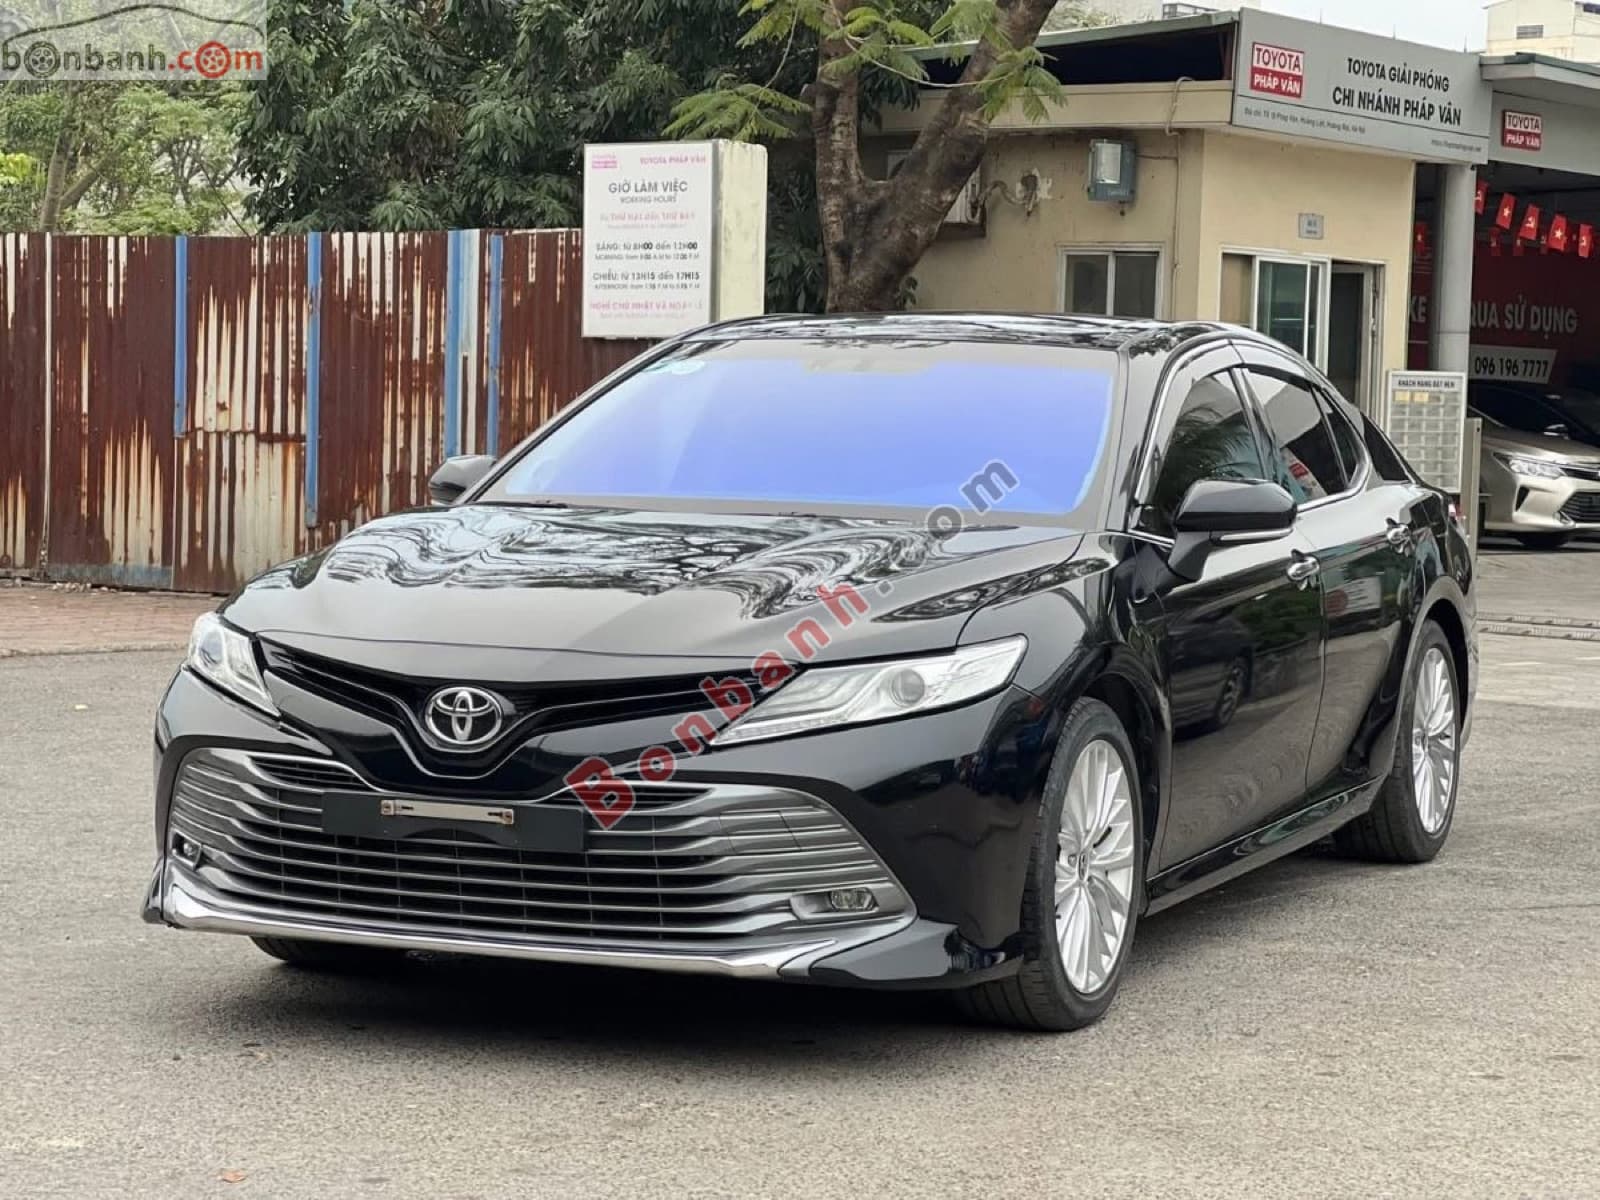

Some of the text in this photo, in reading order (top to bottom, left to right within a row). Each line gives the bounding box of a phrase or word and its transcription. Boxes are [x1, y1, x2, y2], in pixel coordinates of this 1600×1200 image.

[1255, 47, 1301, 72] TOYOTA
[1253, 72, 1301, 95] PHÁP VÂN
[1347, 57, 1450, 92] TOYOTA GIẢI PHÓNG
[1332, 86, 1462, 127] CHI NHÁNH PHÁP VÂN
[1507, 114, 1540, 131] TOYOTA
[608, 177, 689, 195] GIỜ LÀM VIỆC
[1504, 293, 1528, 330] SỬ
[1530, 303, 1577, 340] DỤNG
[1474, 356, 1549, 377] 096 196 7777
